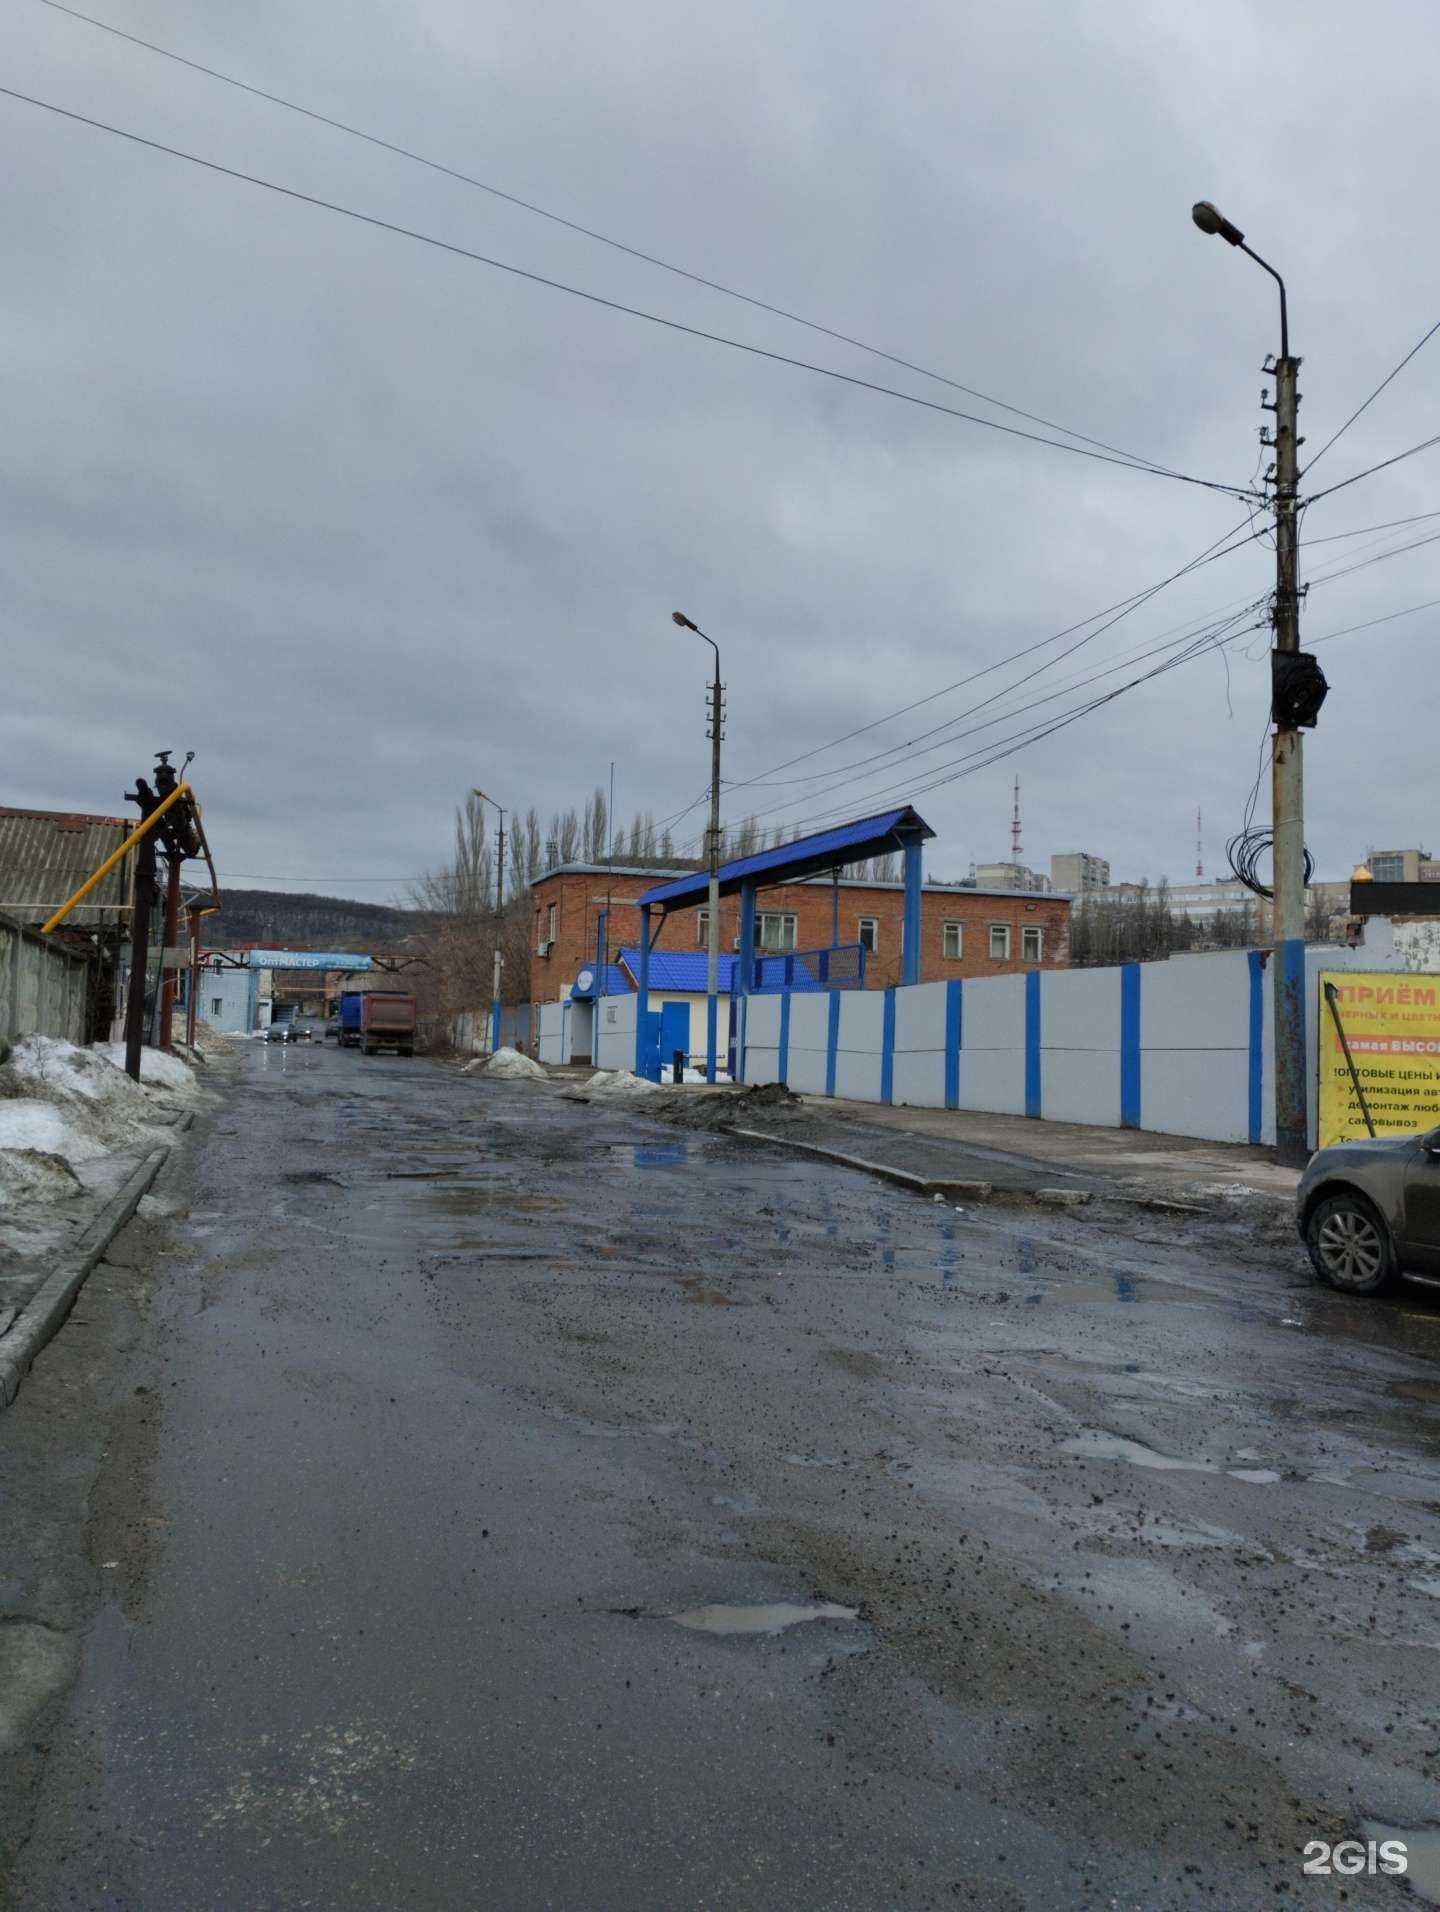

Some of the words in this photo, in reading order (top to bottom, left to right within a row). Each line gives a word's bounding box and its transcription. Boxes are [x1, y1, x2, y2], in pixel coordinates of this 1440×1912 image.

[1336, 983, 1436, 1006] ПРИЁМ
[1399, 1071, 1432, 1080] ЦЕНЫ
[1348, 1086, 1420, 1096] уилизация
[1413, 1104, 1440, 1112] люб
